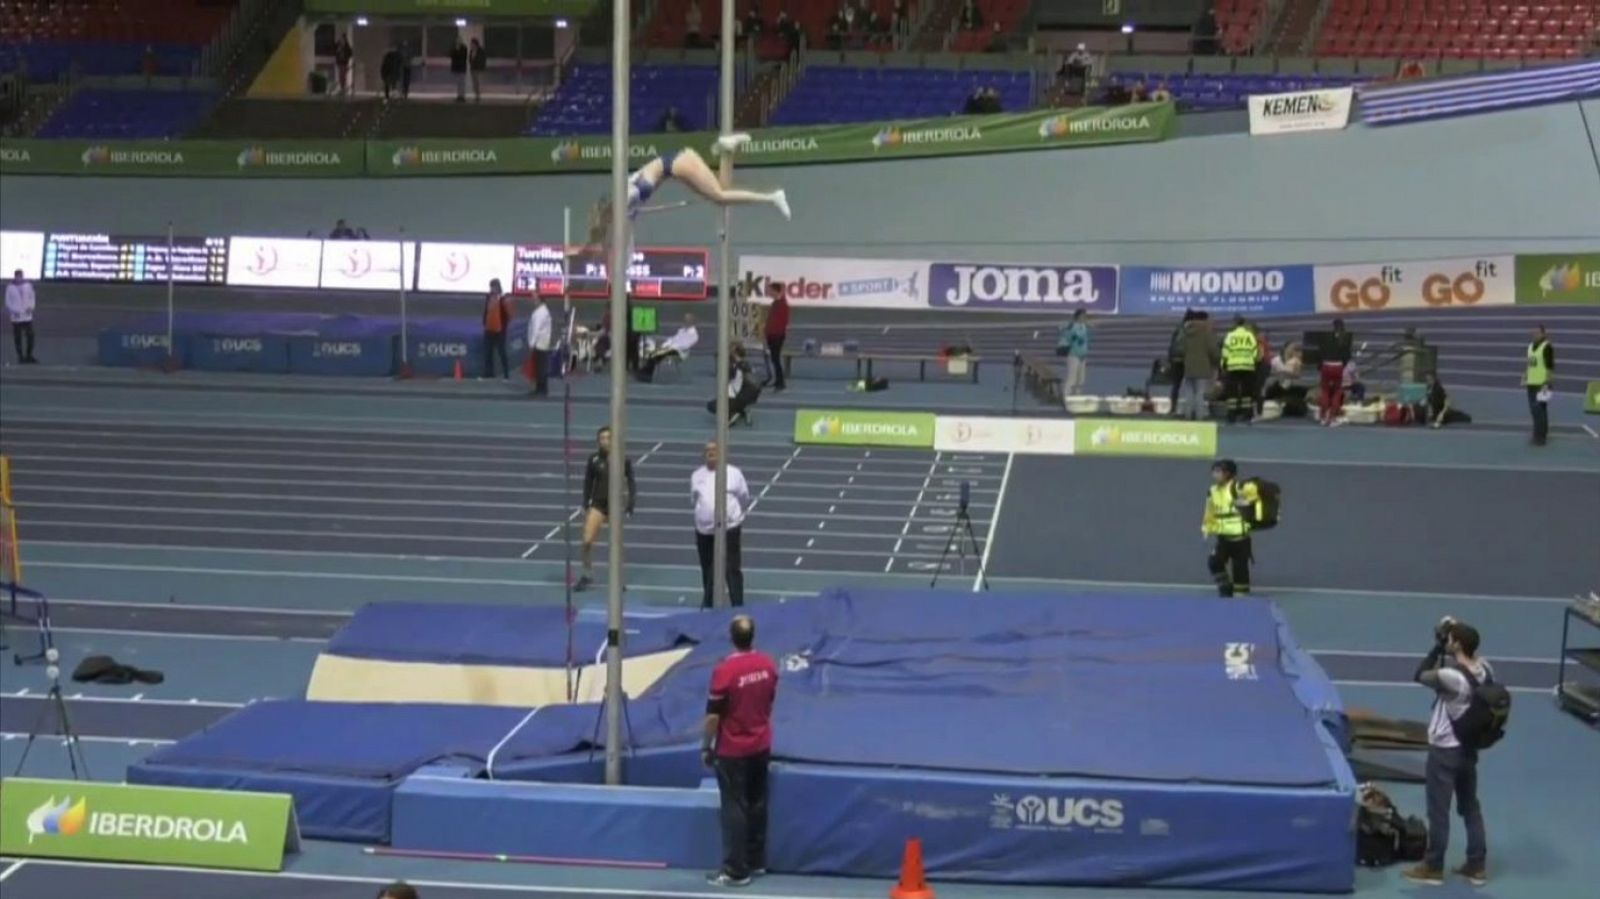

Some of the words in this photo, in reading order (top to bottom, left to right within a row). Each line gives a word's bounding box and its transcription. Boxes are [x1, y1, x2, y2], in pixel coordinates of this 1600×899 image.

[1263, 94, 1319, 117] KEMEN
[1069, 115, 1151, 134] IBERDROLA
[902, 127, 981, 144] IBERDROLA
[110, 151, 183, 164] IBERDROLA
[266, 152, 341, 165] IBERDROLA
[422, 150, 497, 163] IBERDROLA
[1172, 270, 1284, 293] MONDO
[1330, 277, 1391, 310] GO
[1381, 265, 1403, 284] fit
[1421, 271, 1485, 307] GO
[1475, 260, 1498, 279] fit
[440, 343, 467, 356] UCS
[840, 421, 918, 437] IBERDROLA
[1120, 429, 1199, 445] IBERDROLA
[1047, 797, 1124, 828] UCS
[89, 811, 248, 843] IBERDROLA
